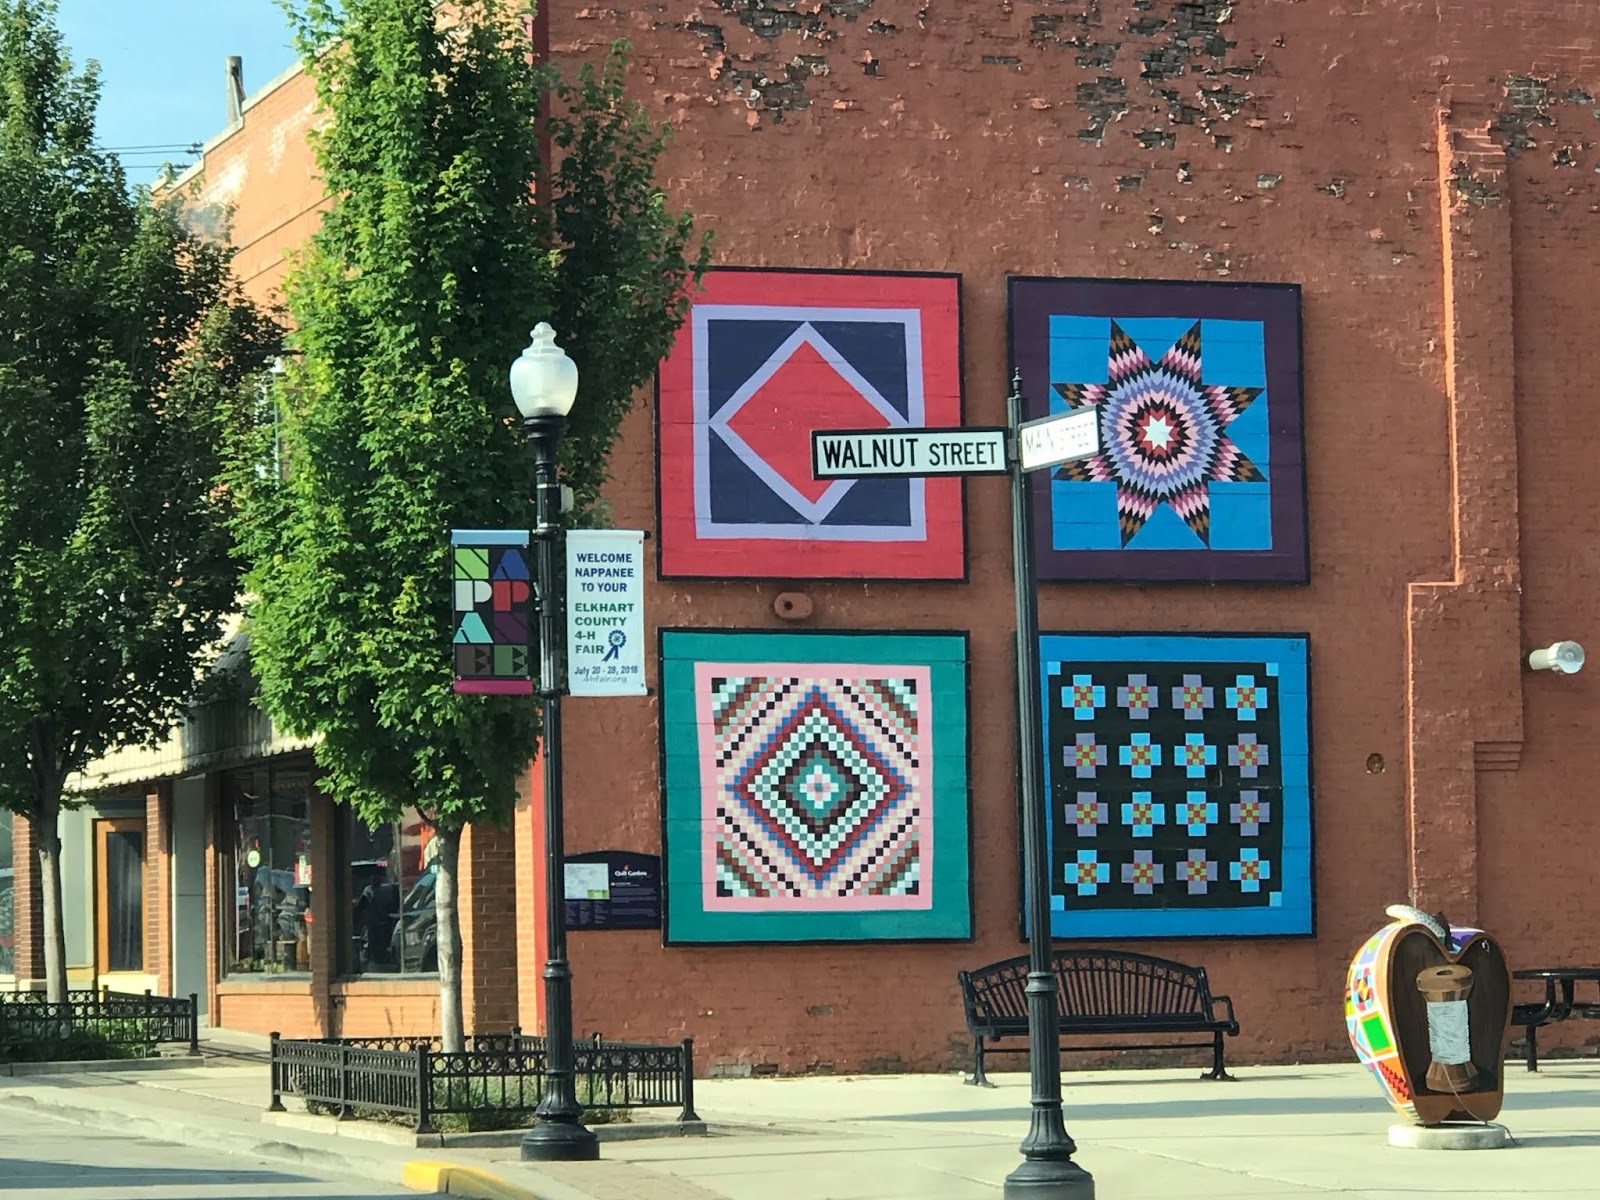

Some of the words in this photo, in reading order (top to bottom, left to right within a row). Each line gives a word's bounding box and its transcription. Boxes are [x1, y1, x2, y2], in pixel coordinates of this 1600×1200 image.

[822, 438, 919, 468] WALNUT
[929, 441, 998, 467] STREET
[576, 553, 633, 563] WELCOME
[575, 567, 634, 578] NAPPANEE
[581, 582, 595, 592] TO
[597, 582, 627, 592] YOUR
[575, 602, 635, 612] ELKHART
[574, 617, 627, 626] COUNTY
[574, 630, 596, 640] 4-H
[575, 645, 605, 654] FAIR
[574, 666, 590, 677] July
[592, 666, 601, 674] 20
[621, 665, 638, 674] 2018
